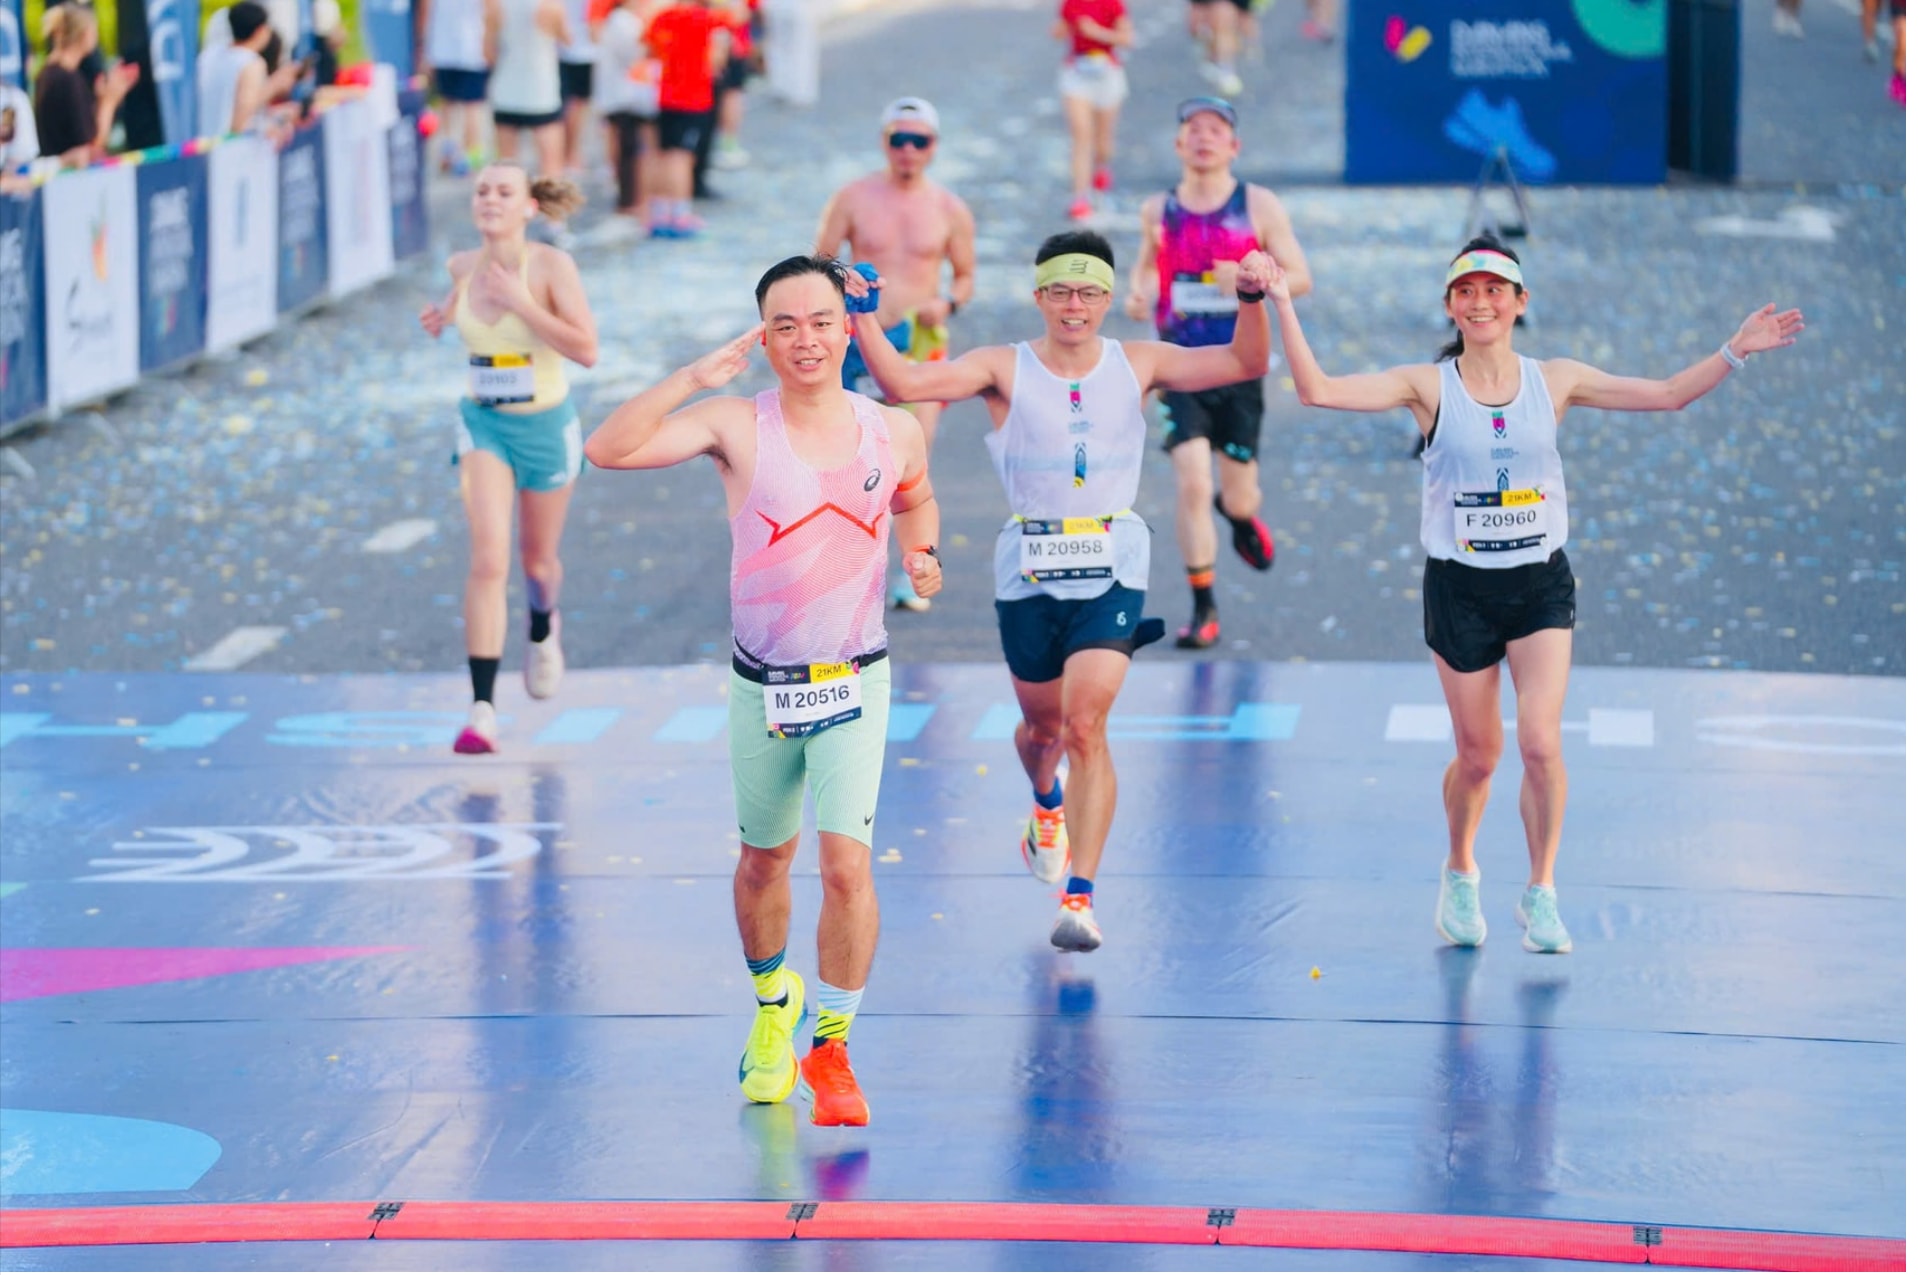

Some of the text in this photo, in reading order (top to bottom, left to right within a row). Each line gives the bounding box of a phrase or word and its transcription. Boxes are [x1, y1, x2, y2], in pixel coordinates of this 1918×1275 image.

[1507, 492, 1532, 503] 21KM
[1466, 510, 1537, 528] F 20960
[1029, 540, 1103, 556] M 20958
[816, 665, 842, 678] 21KM
[775, 685, 850, 709] M 20516
